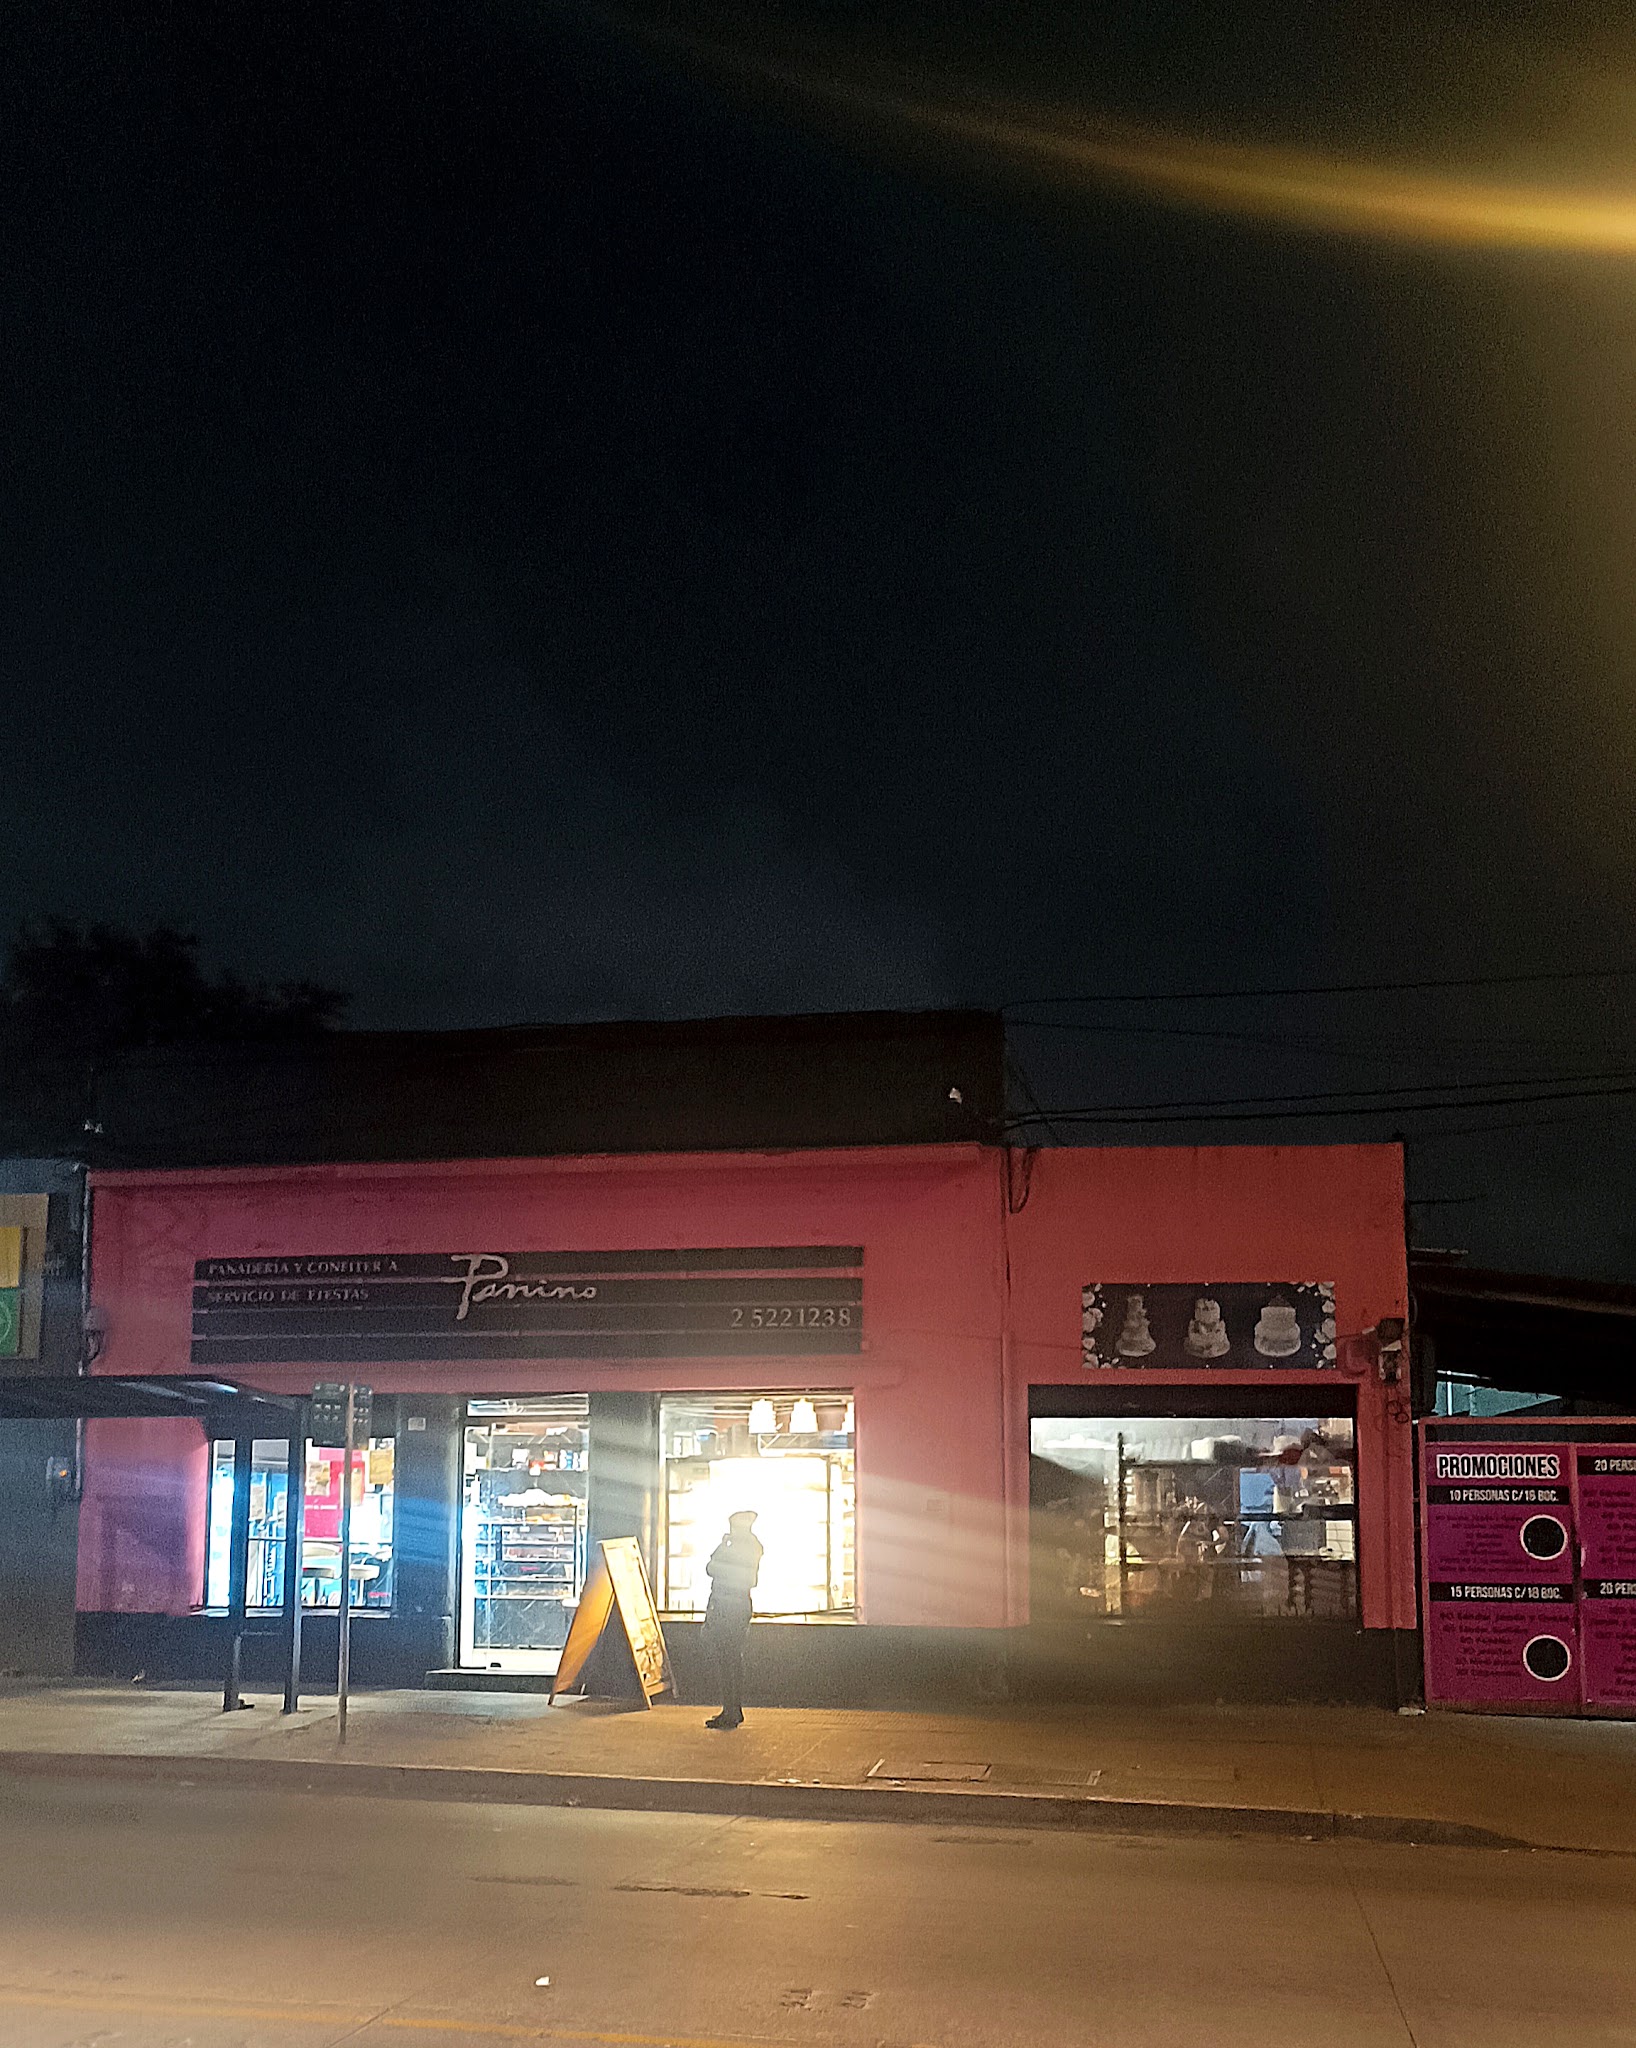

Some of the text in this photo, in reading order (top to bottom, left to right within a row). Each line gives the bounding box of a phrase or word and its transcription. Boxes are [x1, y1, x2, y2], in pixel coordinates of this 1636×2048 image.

[294, 1262, 303, 1274] Y
[441, 1253, 598, 1321] Panino
[308, 1288, 369, 1302] FIESTAS
[1436, 1454, 1561, 1479] PROMOCIONES
[1594, 1459, 1608, 1471] 20
[1450, 1489, 1461, 1501] 10
[1463, 1489, 1510, 1501] PERSONAS
[1450, 1586, 1462, 1598] 15
[1464, 1586, 1513, 1599] PERSONAS
[1600, 1582, 1614, 1595] 20
